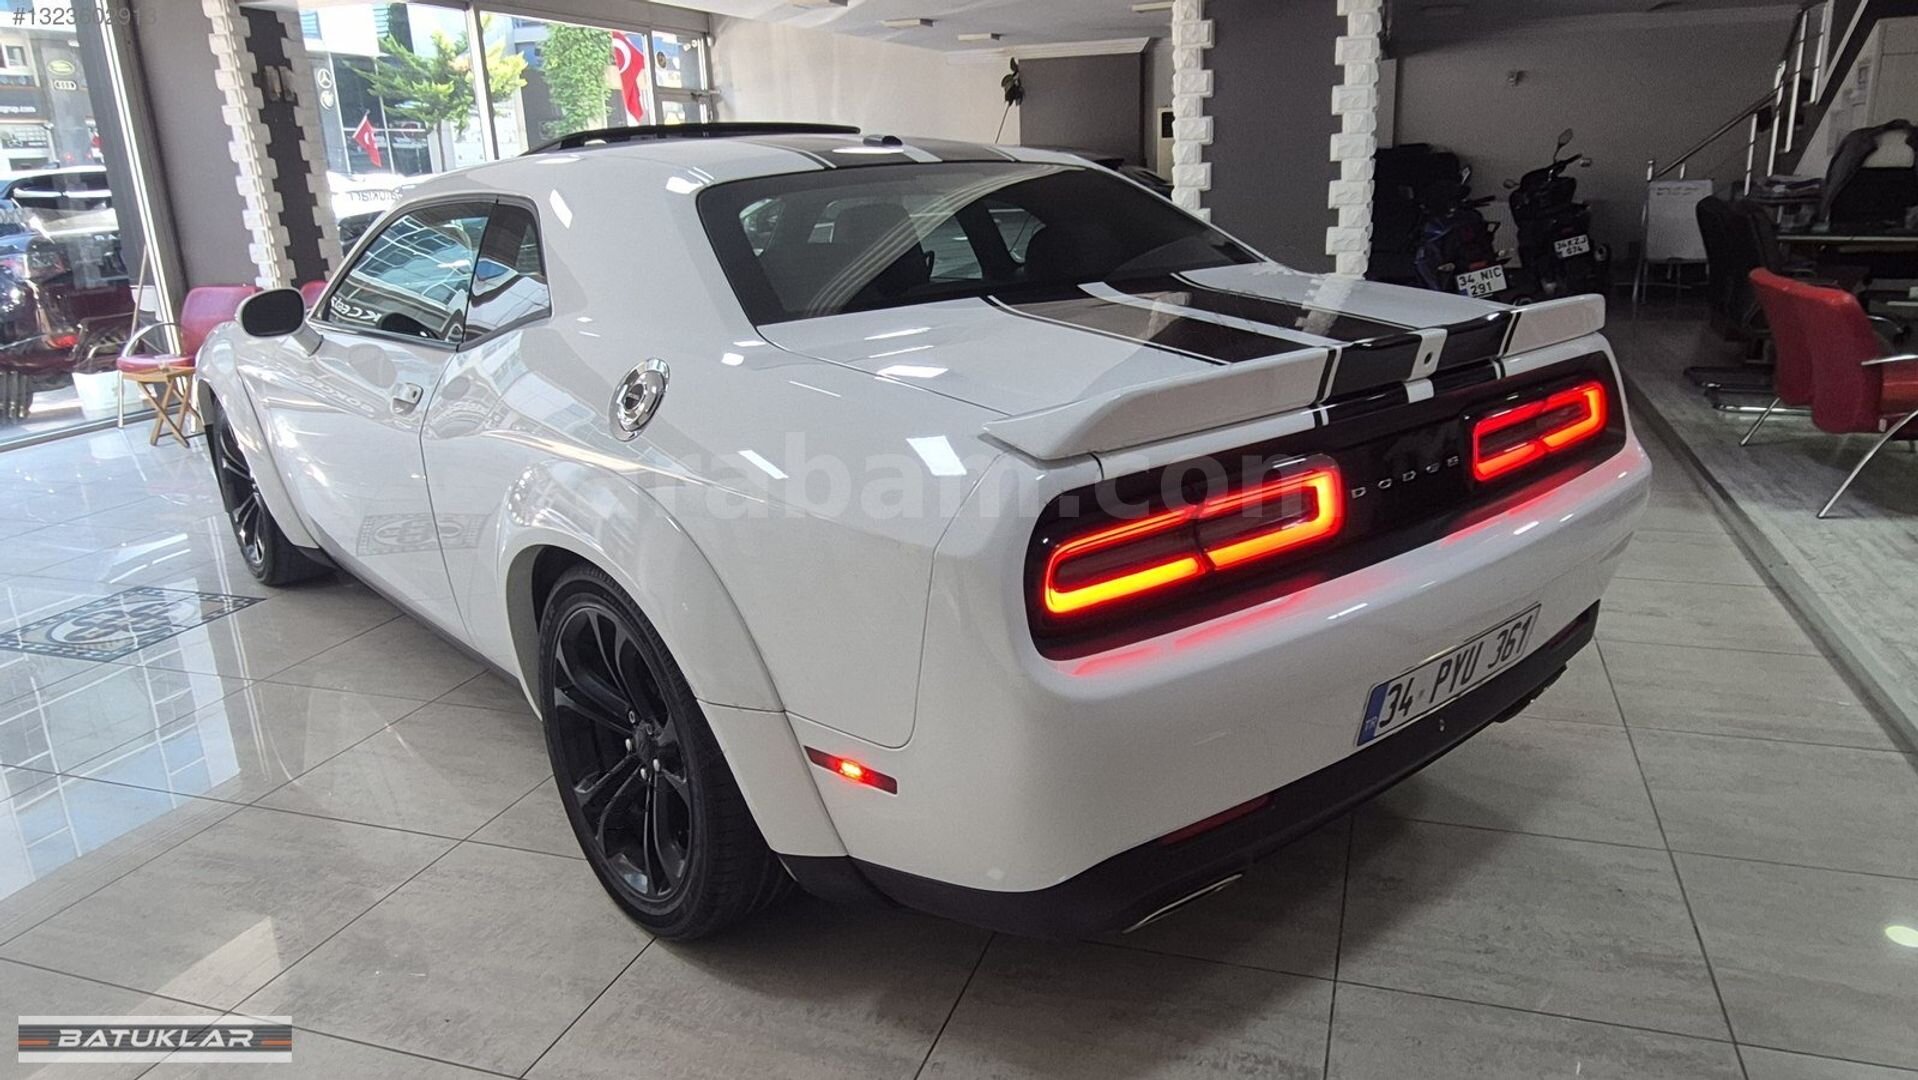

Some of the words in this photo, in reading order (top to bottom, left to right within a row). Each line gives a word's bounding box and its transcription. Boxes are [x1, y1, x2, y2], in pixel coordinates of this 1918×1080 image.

[1458, 275, 1475, 287] 34
[1480, 266, 1502, 281] NIC
[1470, 281, 1493, 296] 291
[1351, 455, 1459, 499] DODGE
[1378, 676, 1416, 729] 34
[1429, 640, 1484, 704] PYU
[1487, 614, 1534, 670] 361
